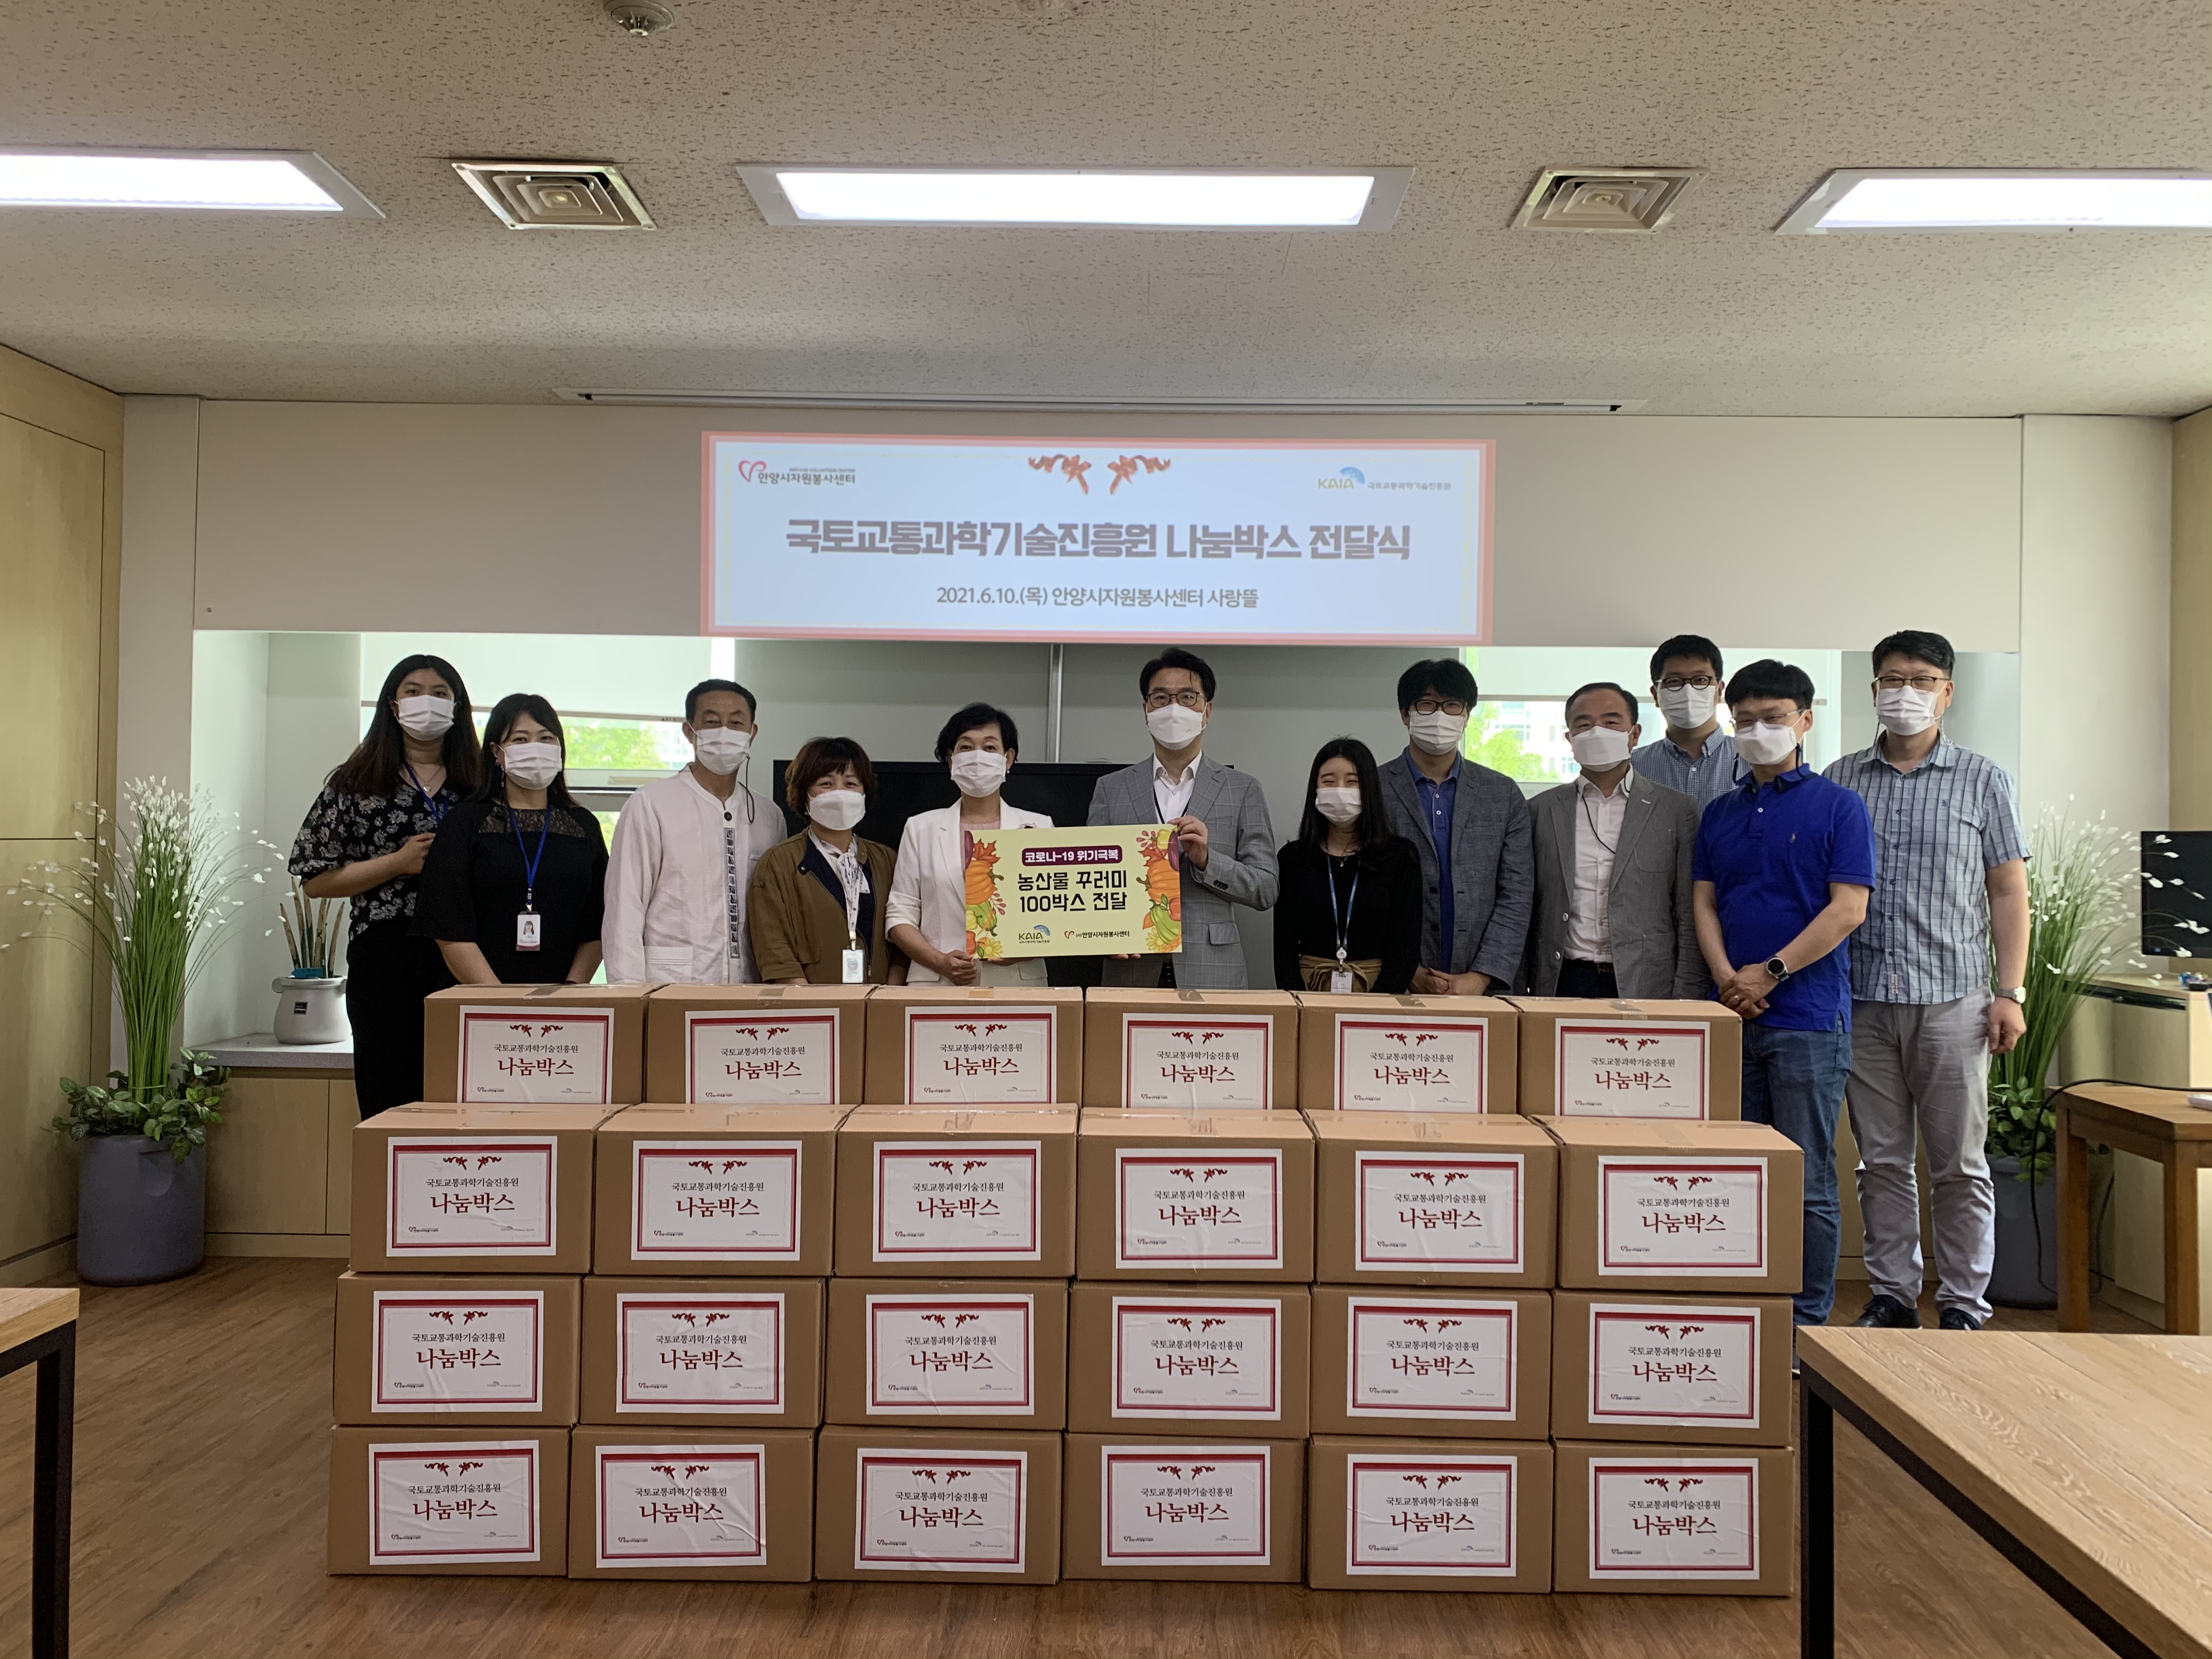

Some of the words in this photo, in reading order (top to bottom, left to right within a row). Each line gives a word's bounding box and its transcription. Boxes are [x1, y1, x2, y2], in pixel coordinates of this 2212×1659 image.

[758, 472, 855, 485] 안양시자원봉사센터
[1318, 478, 1354, 489] KAIA
[786, 519, 1157, 558] 국토교통과학기술진흥원
[1166, 523, 1302, 560] 나눔박스
[1308, 524, 1410, 560] 전달식
[936, 586, 1047, 606] 2021.6.10.(목)
[1052, 587, 1203, 608] 안양시자원봉사센터
[1207, 588, 1259, 608] 사랑뜰
[1024, 850, 1074, 864] 코로나-19
[1077, 848, 1119, 862] 위기극복
[1017, 872, 1069, 891] 농산물
[1076, 870, 1127, 890] 꾸러미
[1019, 893, 1086, 912] 100박스
[1093, 892, 1127, 911] 전달
[1019, 932, 1043, 940] KAIA
[494, 1043, 579, 1054] 국토교통과학기술진흥원
[721, 1046, 806, 1058] 국토교통과학기술진흥원
[940, 1043, 1023, 1054] 국토교통과학기술진흥원
[1157, 1051, 1240, 1062] 국토교통과학기술진흥원
[498, 1057, 574, 1077] 나눔박스
[944, 1057, 1020, 1077] 나눔박스
[1370, 1052, 1454, 1064] 국토교통과학기술진흥원
[1591, 1057, 1676, 1069] 국토교통과학기술진흥원
[725, 1060, 802, 1081] 나눔박스
[1161, 1064, 1236, 1084] 나눔박스
[1374, 1065, 1451, 1086] 나눔박스
[1595, 1070, 1672, 1091] 나눔박스
[426, 1177, 520, 1189] 국토교통과학기술진흥원
[672, 1182, 765, 1193] 국토교통과학기술진흥원
[913, 1182, 1005, 1194] 국토교통과학기술진흥원
[431, 1193, 515, 1215] 나눔박스
[1154, 1190, 1245, 1201] 국토교통과학기술진흥원
[1394, 1193, 1487, 1205] 국토교통과학기술진흥원
[1638, 1198, 1730, 1209] 국토교통과학기술진흥원
[676, 1197, 760, 1219] 나눔박스
[917, 1197, 1001, 1220] 나눔박스
[1159, 1205, 1242, 1227] 나눔박스
[1399, 1208, 1483, 1231] 나눔박스
[1642, 1212, 1726, 1235] 나눔박스
[412, 1333, 506, 1344] 국토교통과학기술진흥원
[656, 1334, 747, 1346] 국토교통과학기술진흥원
[905, 1335, 997, 1347] 국토교통과학기술진흥원
[1151, 1340, 1244, 1352] 국토교통과학기술진흥원
[1387, 1340, 1480, 1352] 국토교통과학기술진흥원
[417, 1348, 501, 1370] 나눔박스
[660, 1349, 743, 1372] 나눔박스
[1628, 1346, 1722, 1359] 국토교통과학기술진흥원
[910, 1351, 994, 1373] 나눔박스
[1155, 1355, 1240, 1377] 나눔박스
[1391, 1355, 1476, 1377] 나눔박스
[1633, 1361, 1718, 1384] 나눔박스
[408, 1483, 501, 1496] 국토교통과학기술진흥원
[635, 1487, 727, 1498] 국토교통과학기술진흥원
[895, 1491, 989, 1504] 국토교통과학기술진흥원
[1141, 1487, 1233, 1498] 국토교통과학기술진흥원
[413, 1498, 498, 1521] 나눔박스
[1386, 1497, 1479, 1508] 국토교통과학기술진흥원
[1628, 1500, 1721, 1511] 국토교통과학기술진흥원
[640, 1502, 723, 1525] 나눔박스
[900, 1506, 984, 1529] 나눔박스
[1146, 1502, 1229, 1524] 나눔박스
[1391, 1511, 1475, 1534] 나눔박스
[1633, 1515, 1718, 1537] 나눔박스
